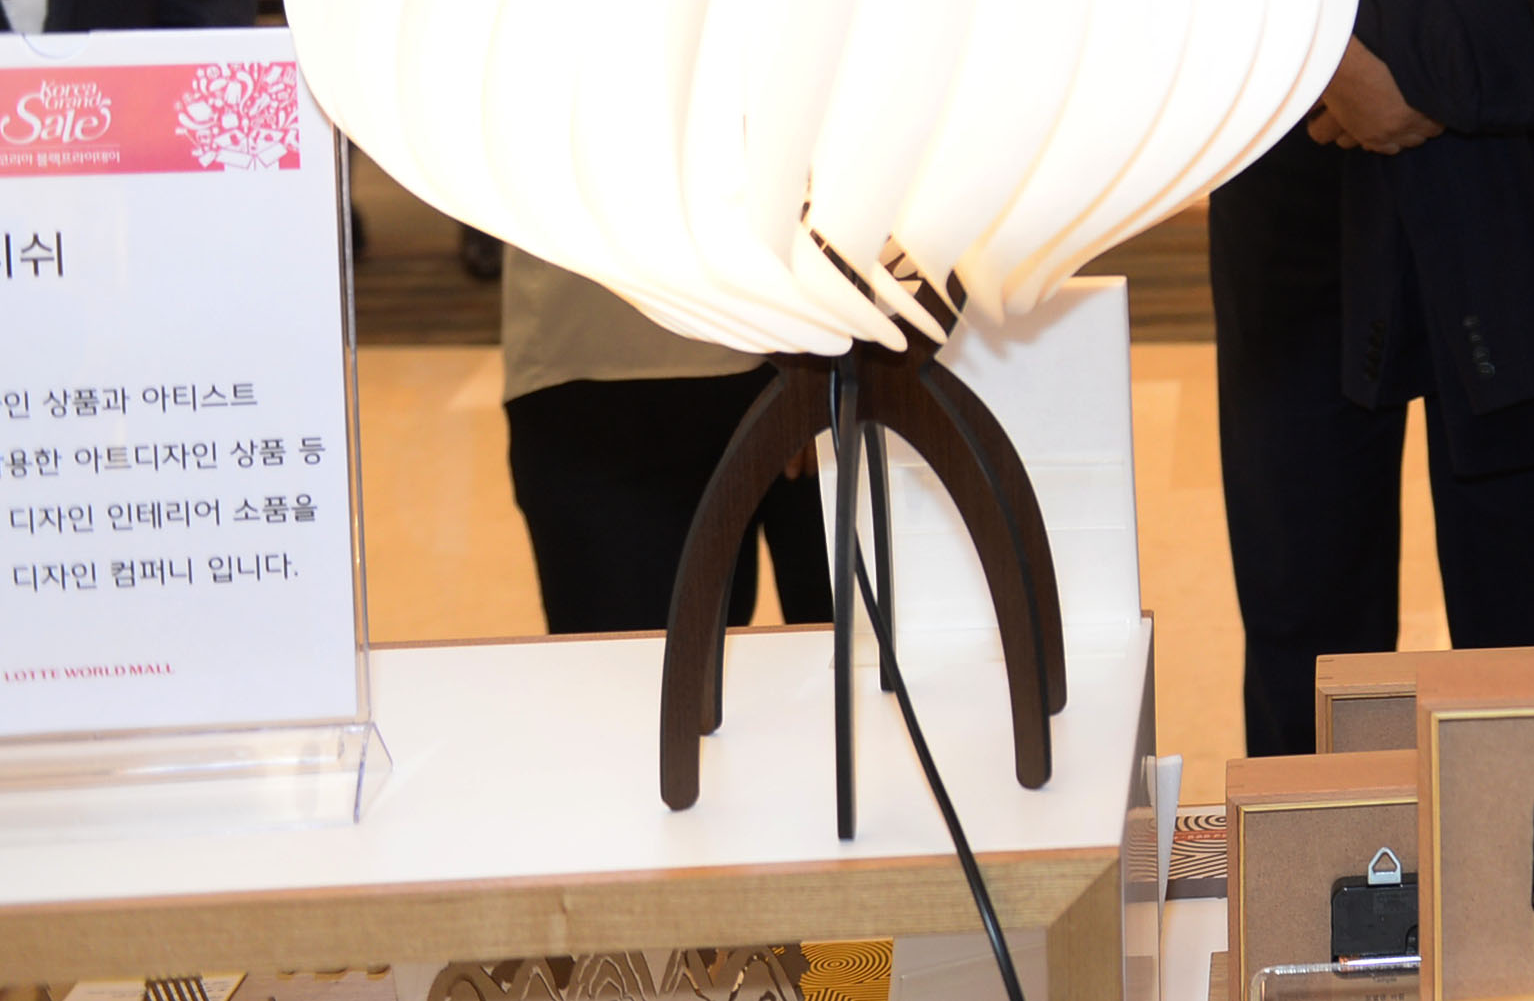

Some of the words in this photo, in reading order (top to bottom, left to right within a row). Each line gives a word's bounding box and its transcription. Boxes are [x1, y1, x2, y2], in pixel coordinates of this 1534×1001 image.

[0, 93, 112, 144] Sale
[0, 231, 64, 279] 쉬
[0, 390, 31, 419] 인
[43, 387, 130, 418] 상품과
[142, 383, 258, 413] 아티스트
[0, 447, 62, 478] 용한
[74, 441, 218, 474] 아트디자인
[230, 439, 286, 469] 상품
[298, 437, 326, 465] 등
[10, 504, 94, 535] 디자인
[107, 499, 222, 531] 인테리어
[233, 494, 318, 524] 소품을
[13, 562, 97, 592] 디자인
[111, 558, 193, 588] 컴퍼니
[208, 553, 298, 583] 입니다.
[4, 668, 59, 682] LOTTE
[64, 665, 126, 679] WORLD
[129, 662, 174, 676] MALL
